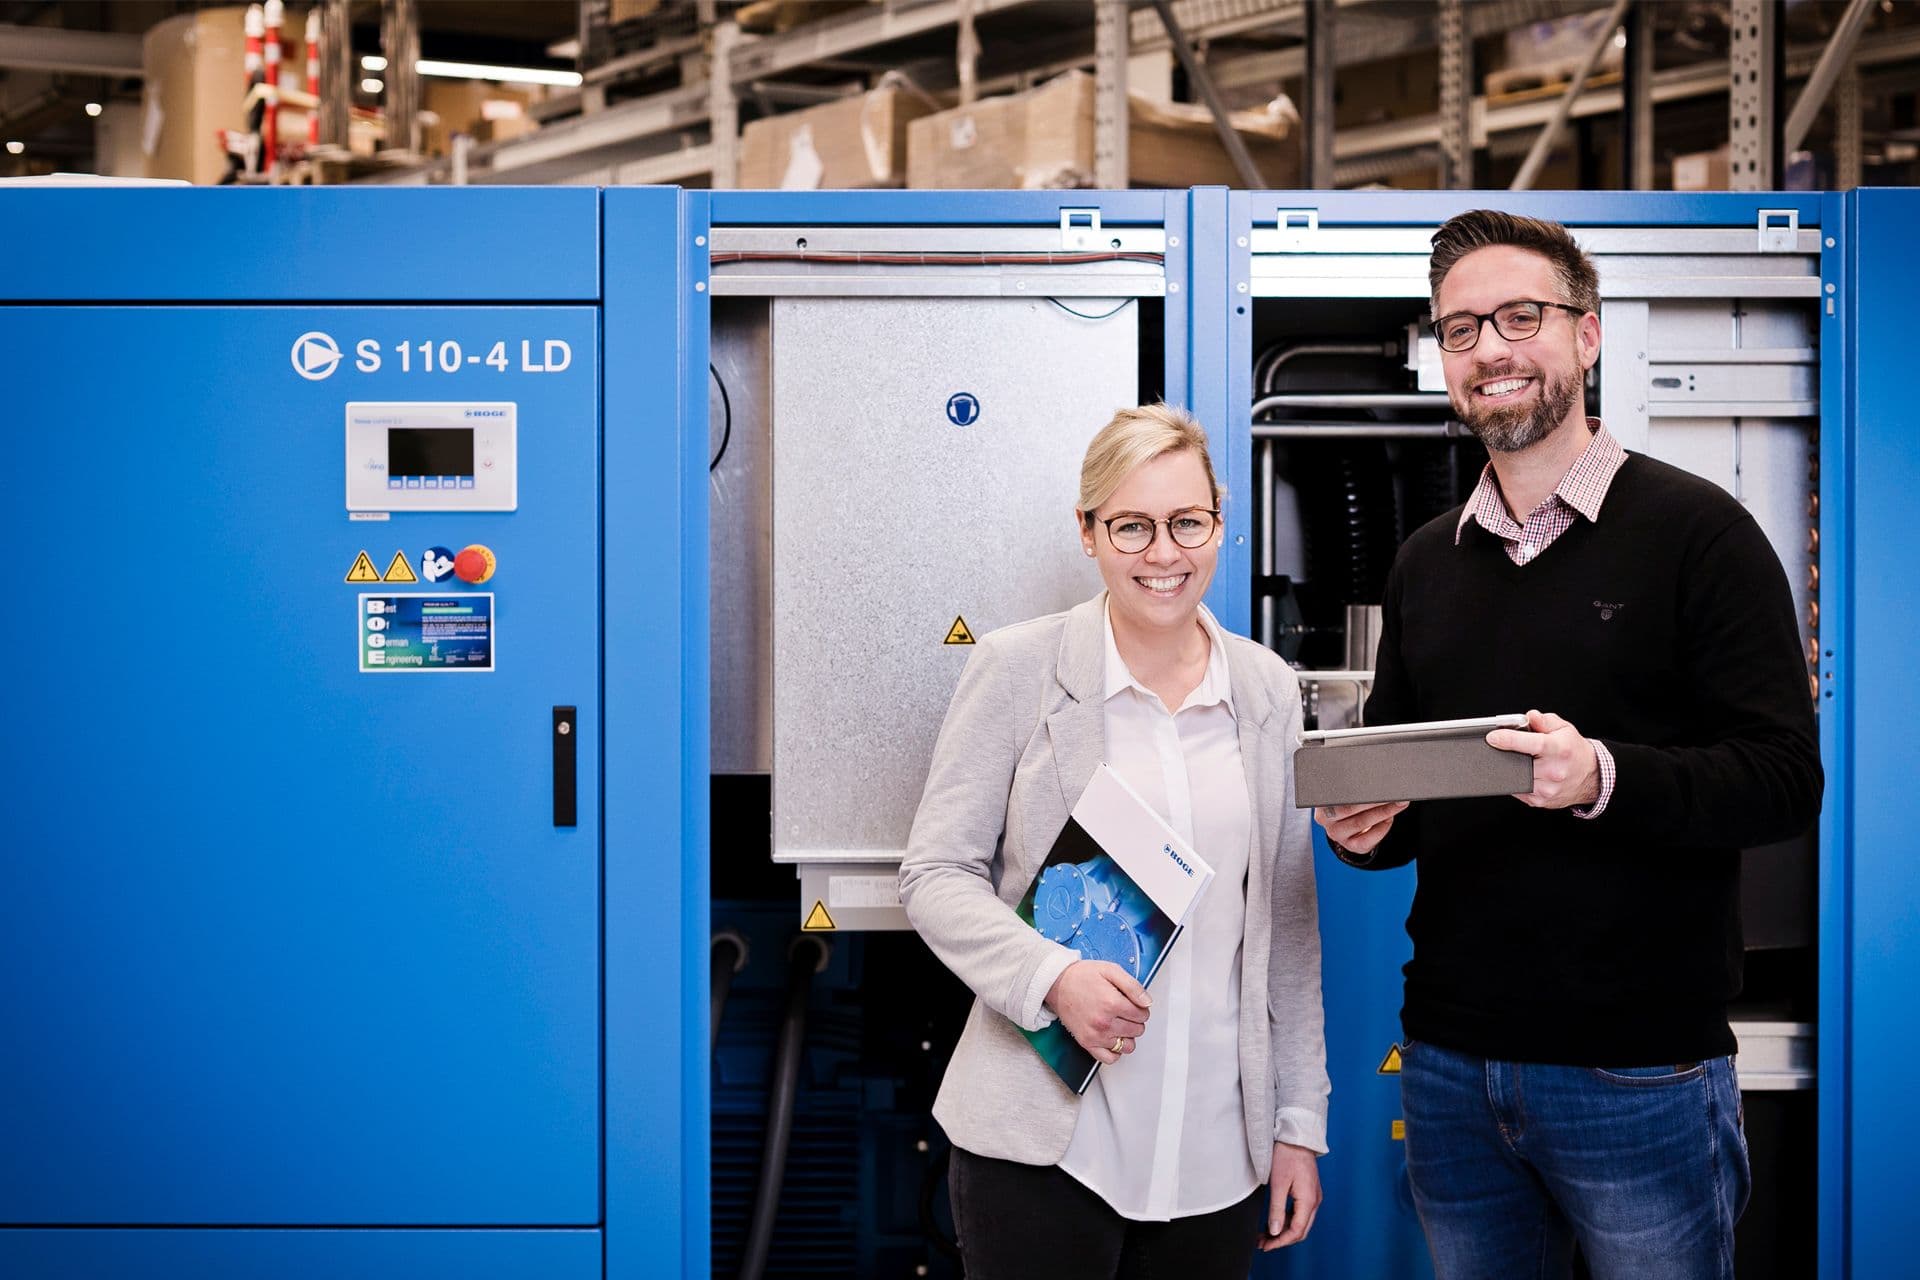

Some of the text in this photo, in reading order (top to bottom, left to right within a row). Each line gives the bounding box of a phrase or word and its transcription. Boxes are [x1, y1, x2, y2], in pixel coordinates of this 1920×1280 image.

[355, 339, 572, 373] S 110-4 LD
[367, 600, 397, 614] Best
[1593, 600, 1624, 609] GANT
[367, 616, 390, 631] Of
[367, 633, 409, 648] German
[367, 650, 423, 666] Engineering
[1170, 850, 1196, 878] BOGE
